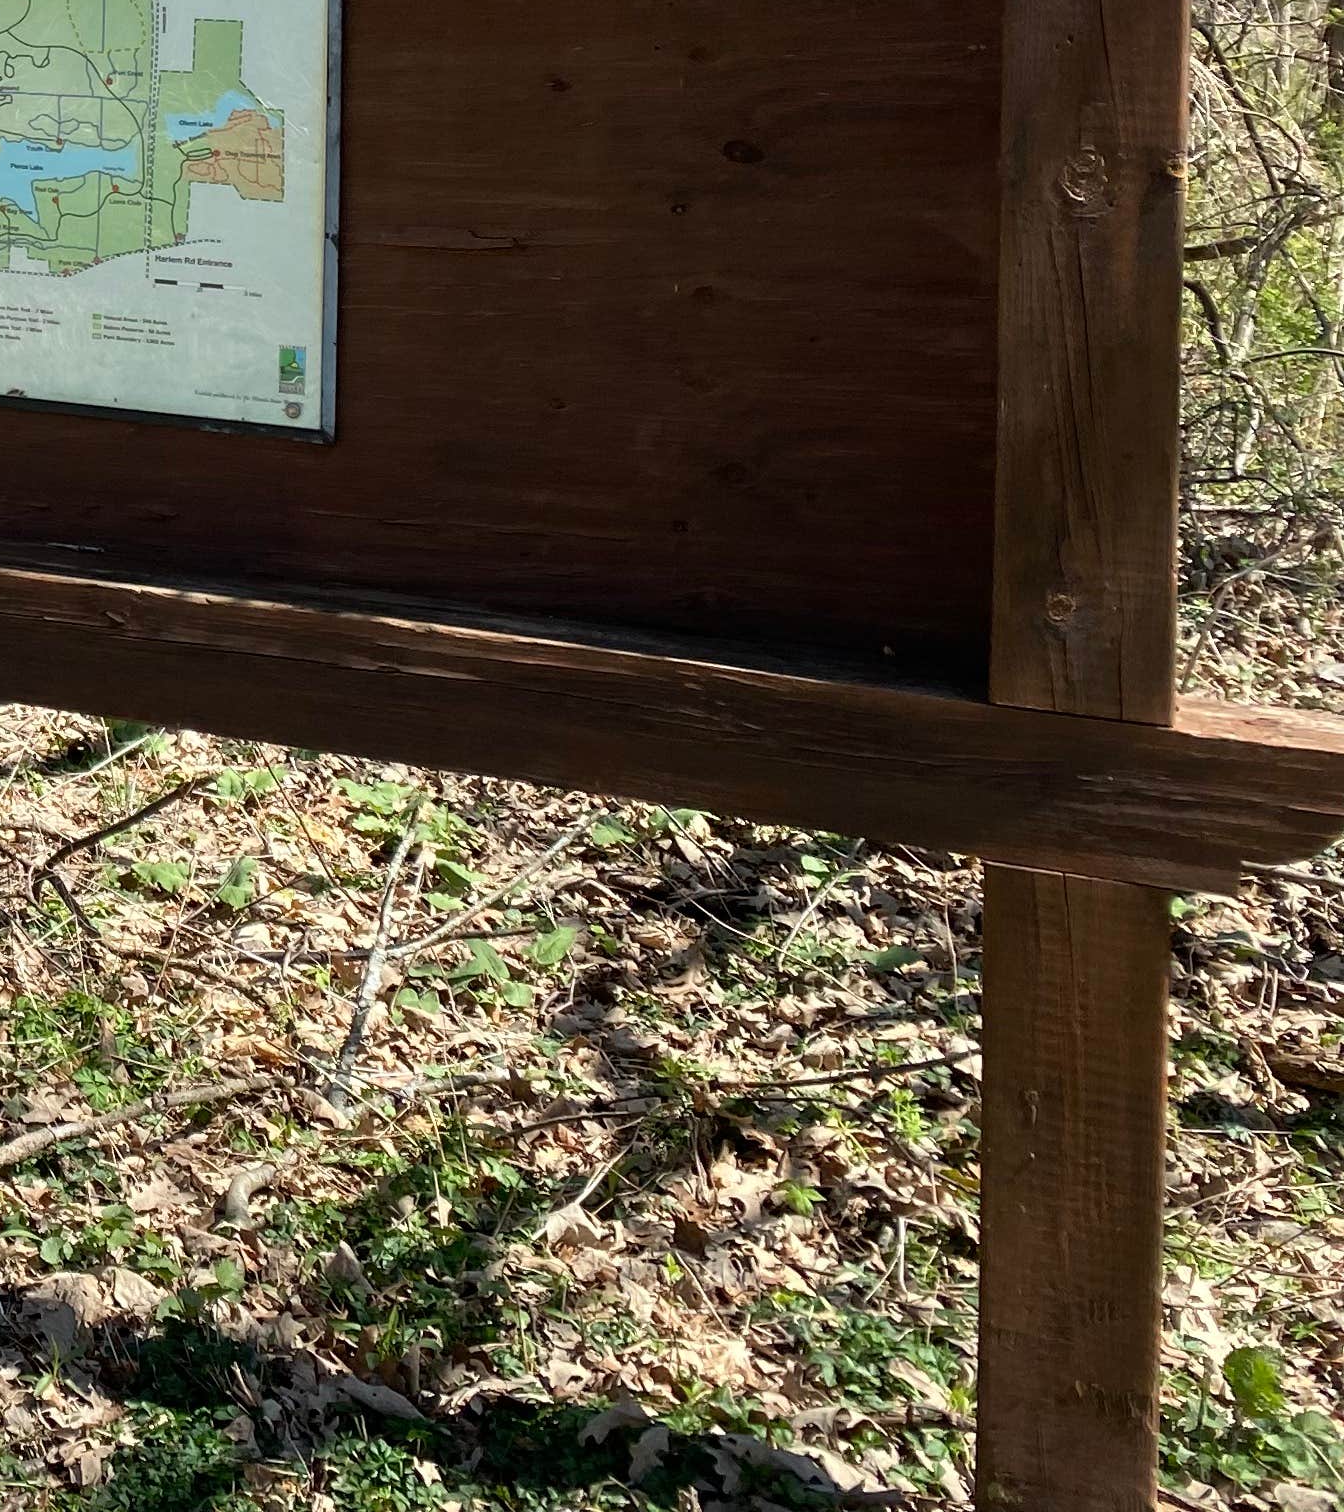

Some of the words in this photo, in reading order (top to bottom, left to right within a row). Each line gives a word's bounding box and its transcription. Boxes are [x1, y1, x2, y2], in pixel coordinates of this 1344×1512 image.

[155, 255, 182, 264] Harlem
[185, 257, 195, 265] Rd
[197, 258, 233, 267] Entrance
